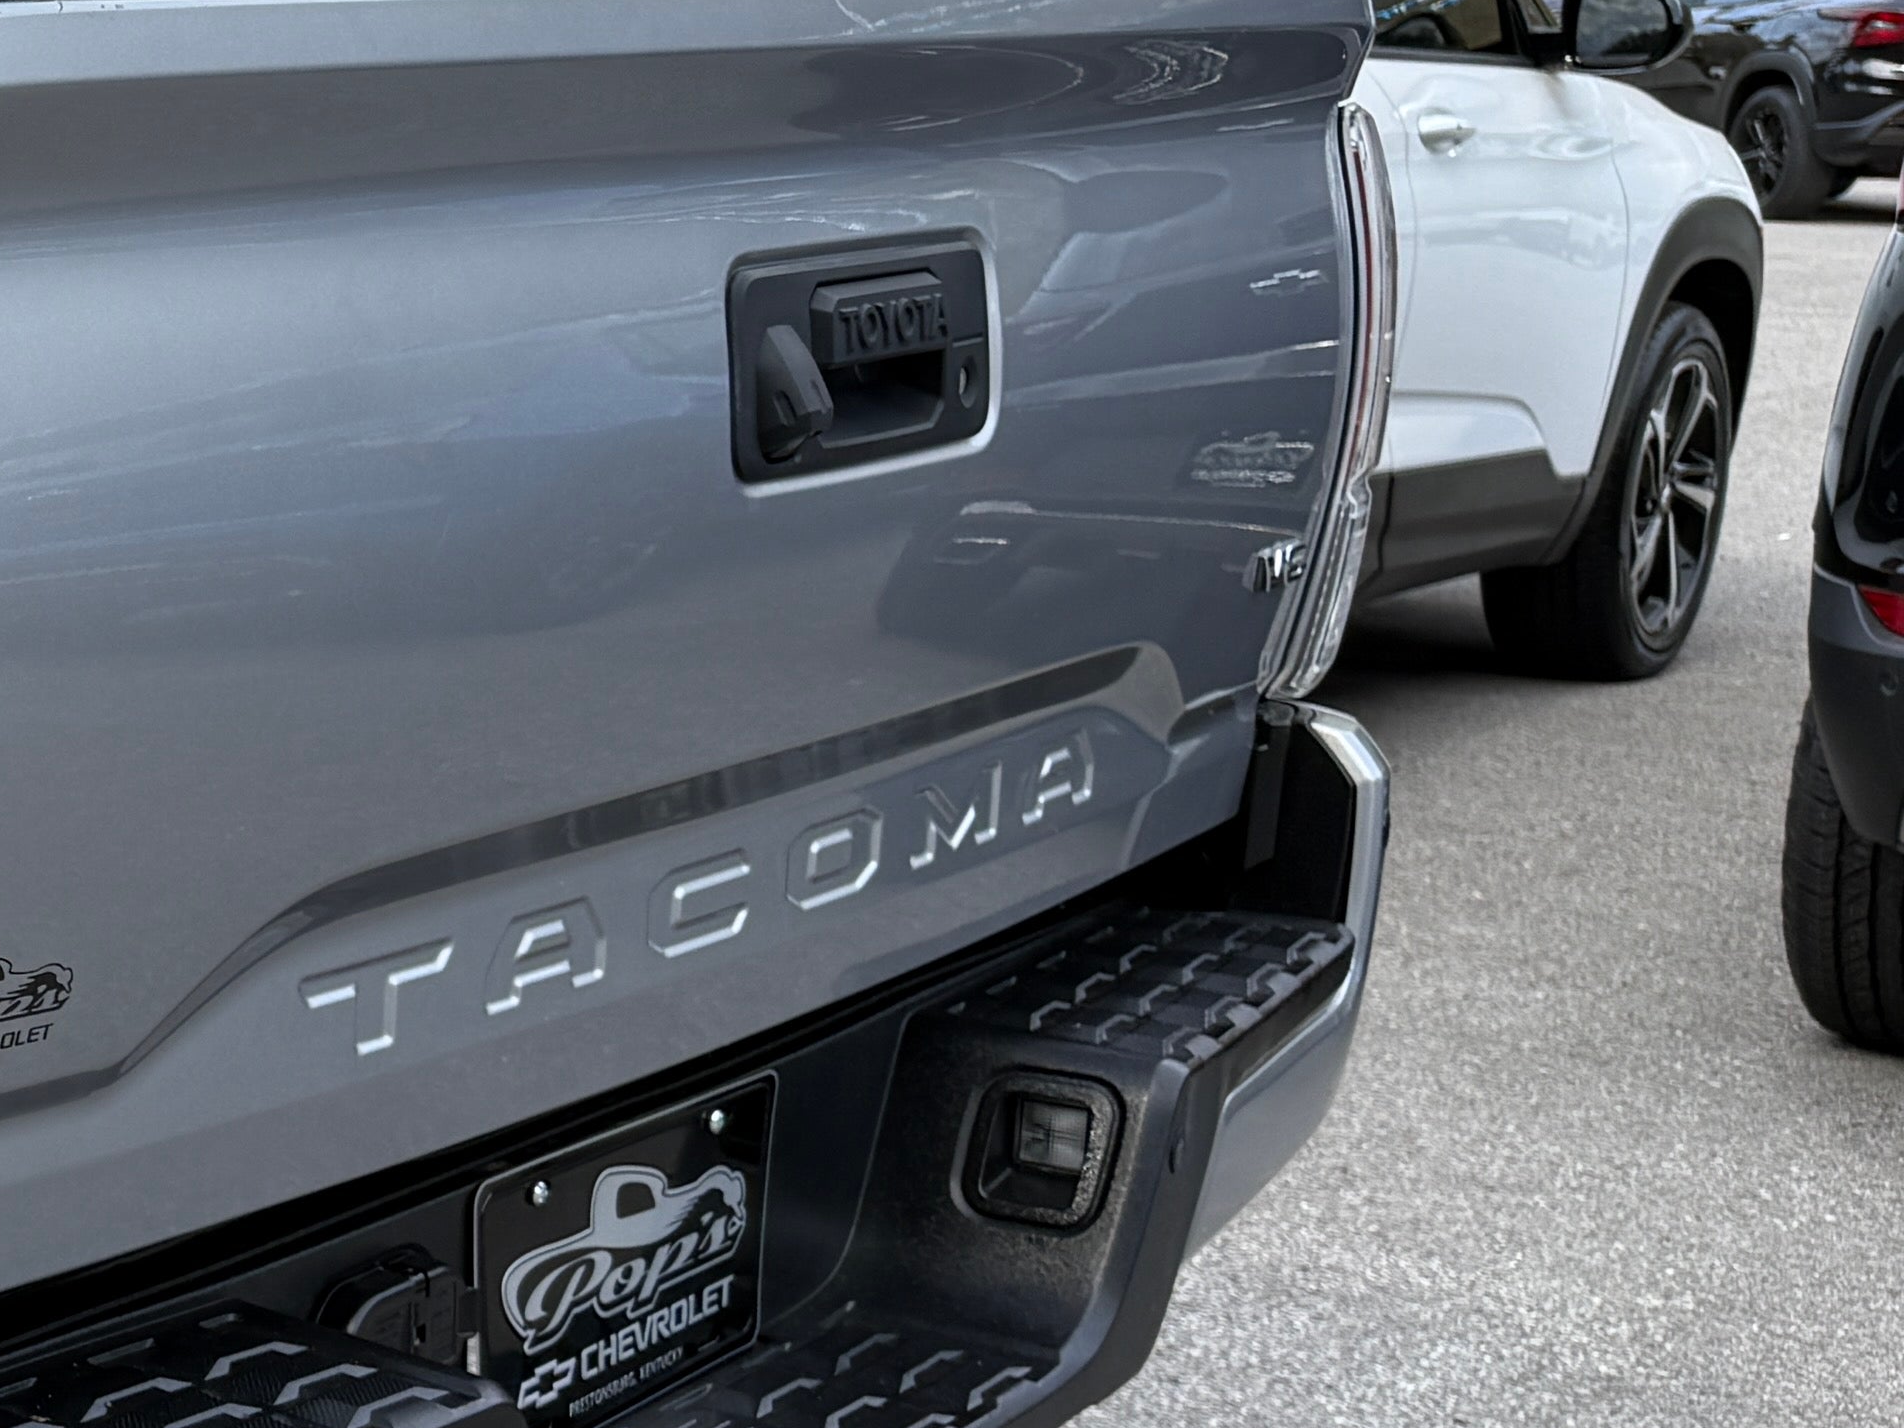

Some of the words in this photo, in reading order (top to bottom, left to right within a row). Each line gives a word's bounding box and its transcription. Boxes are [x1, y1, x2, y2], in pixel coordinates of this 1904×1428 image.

[838, 292, 949, 357] TOYOTA
[298, 727, 1095, 1056] TACOMA
[580, 1273, 735, 1380] CHEVROLET
